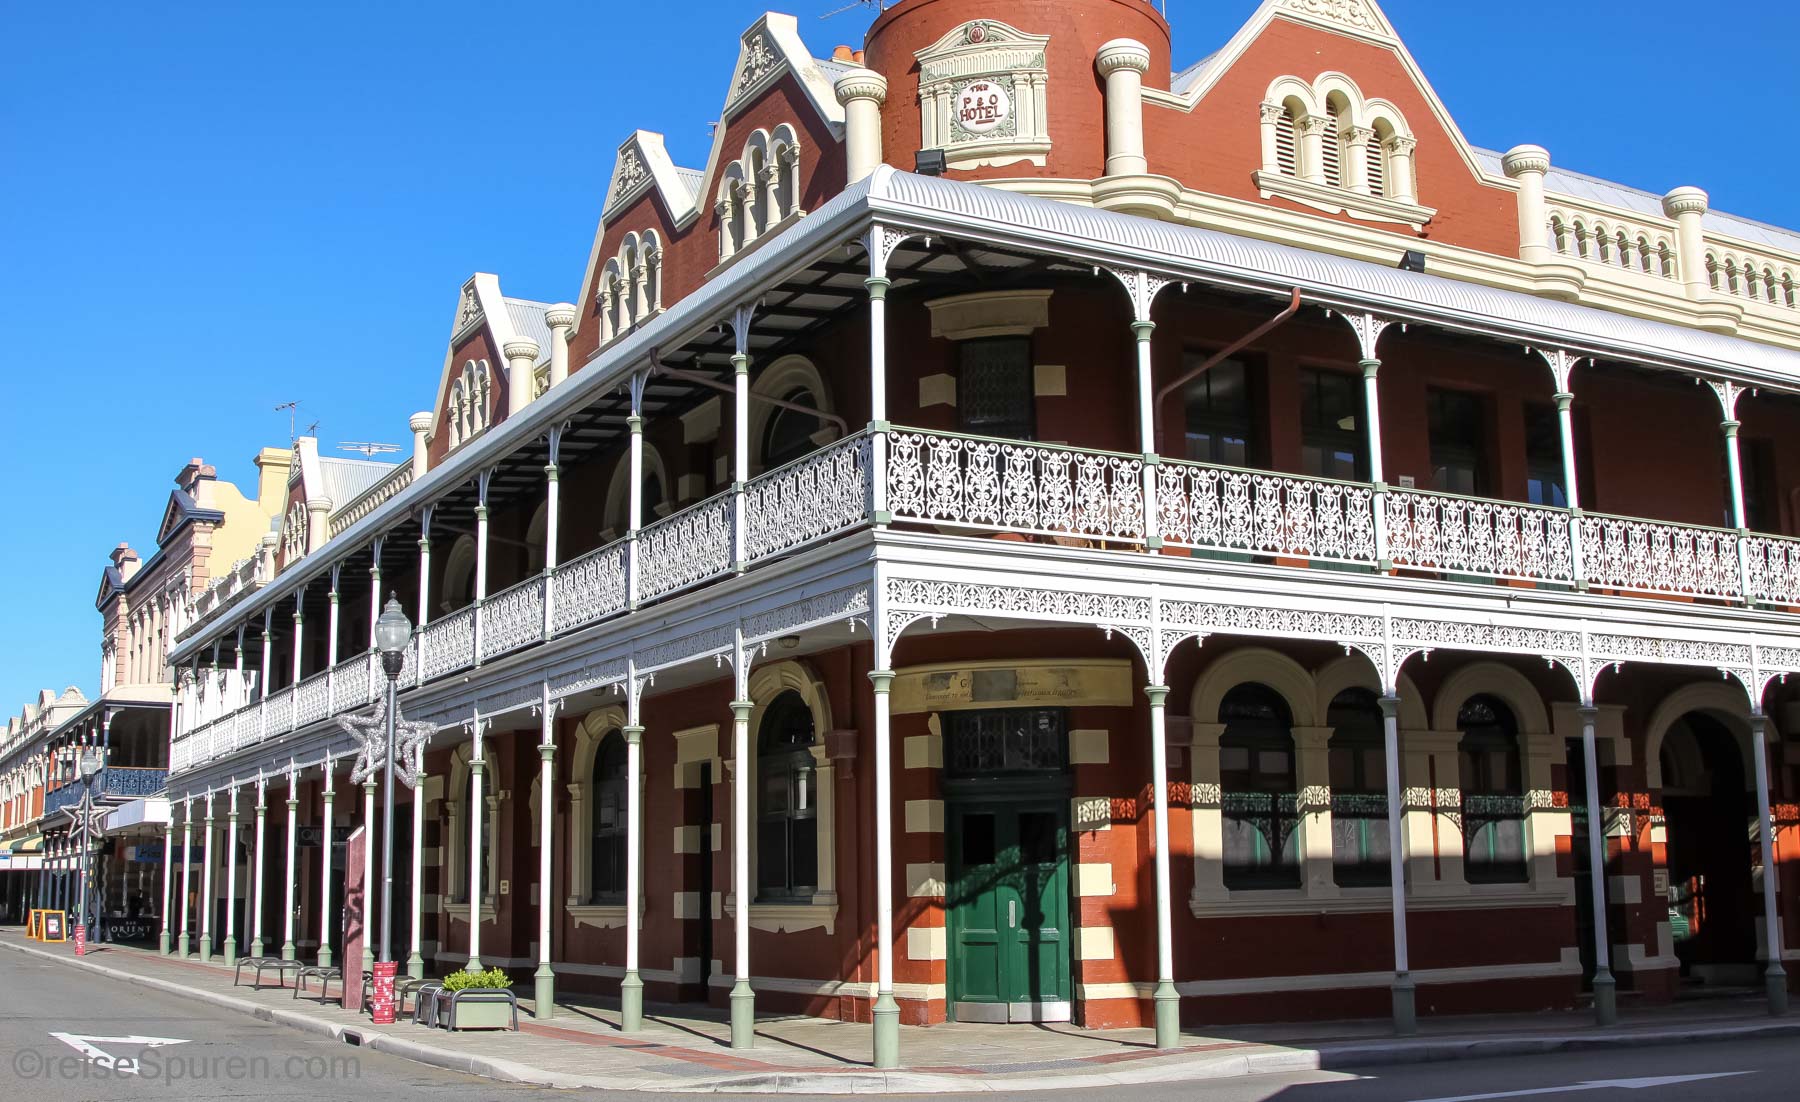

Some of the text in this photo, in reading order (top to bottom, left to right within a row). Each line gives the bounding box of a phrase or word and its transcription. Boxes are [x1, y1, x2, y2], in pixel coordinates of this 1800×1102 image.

[963, 94, 998, 109] P & O
[960, 105, 1003, 122] HOTEL
[111, 925, 152, 933] ORIENT
